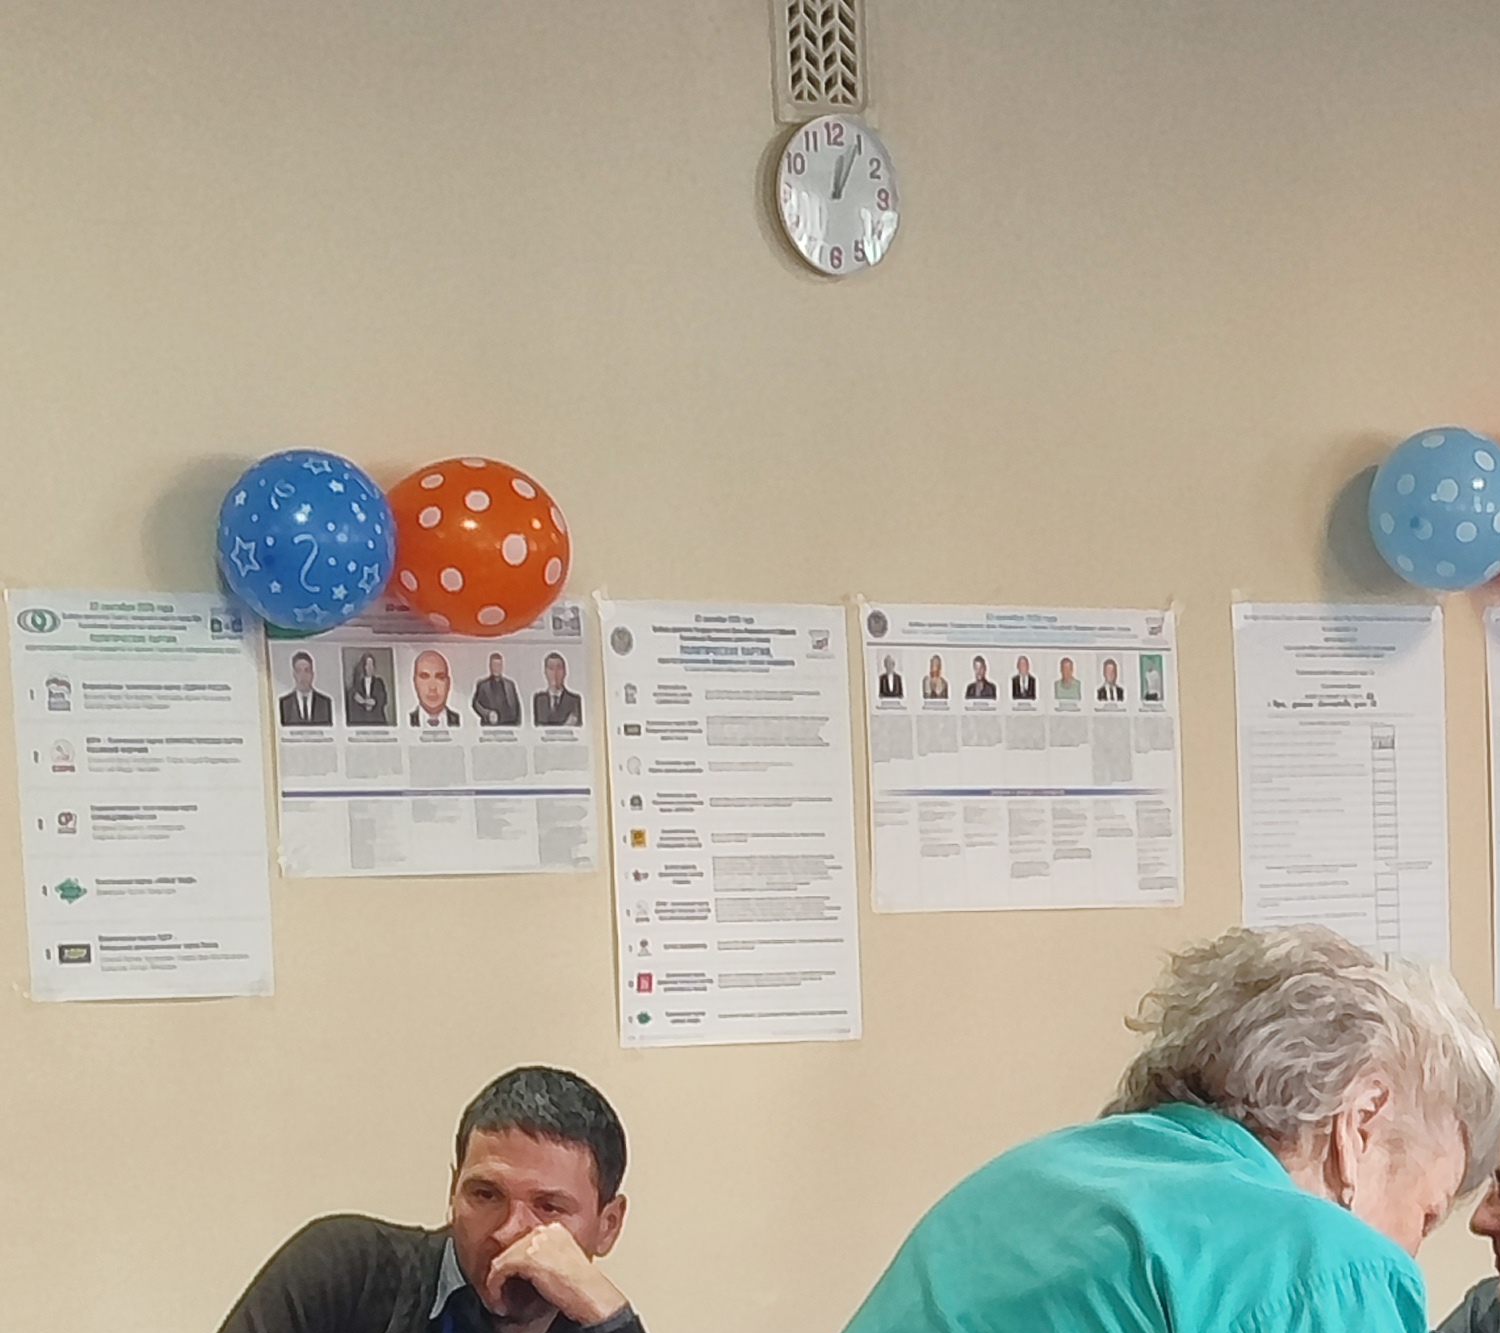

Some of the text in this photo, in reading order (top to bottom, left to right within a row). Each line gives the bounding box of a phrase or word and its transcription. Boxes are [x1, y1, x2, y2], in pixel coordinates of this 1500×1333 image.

[804, 131, 818, 152] 11
[824, 122, 844, 146] 12
[856, 134, 863, 155] 1
[787, 151, 805, 175] 10
[869, 157, 881, 179] 2
